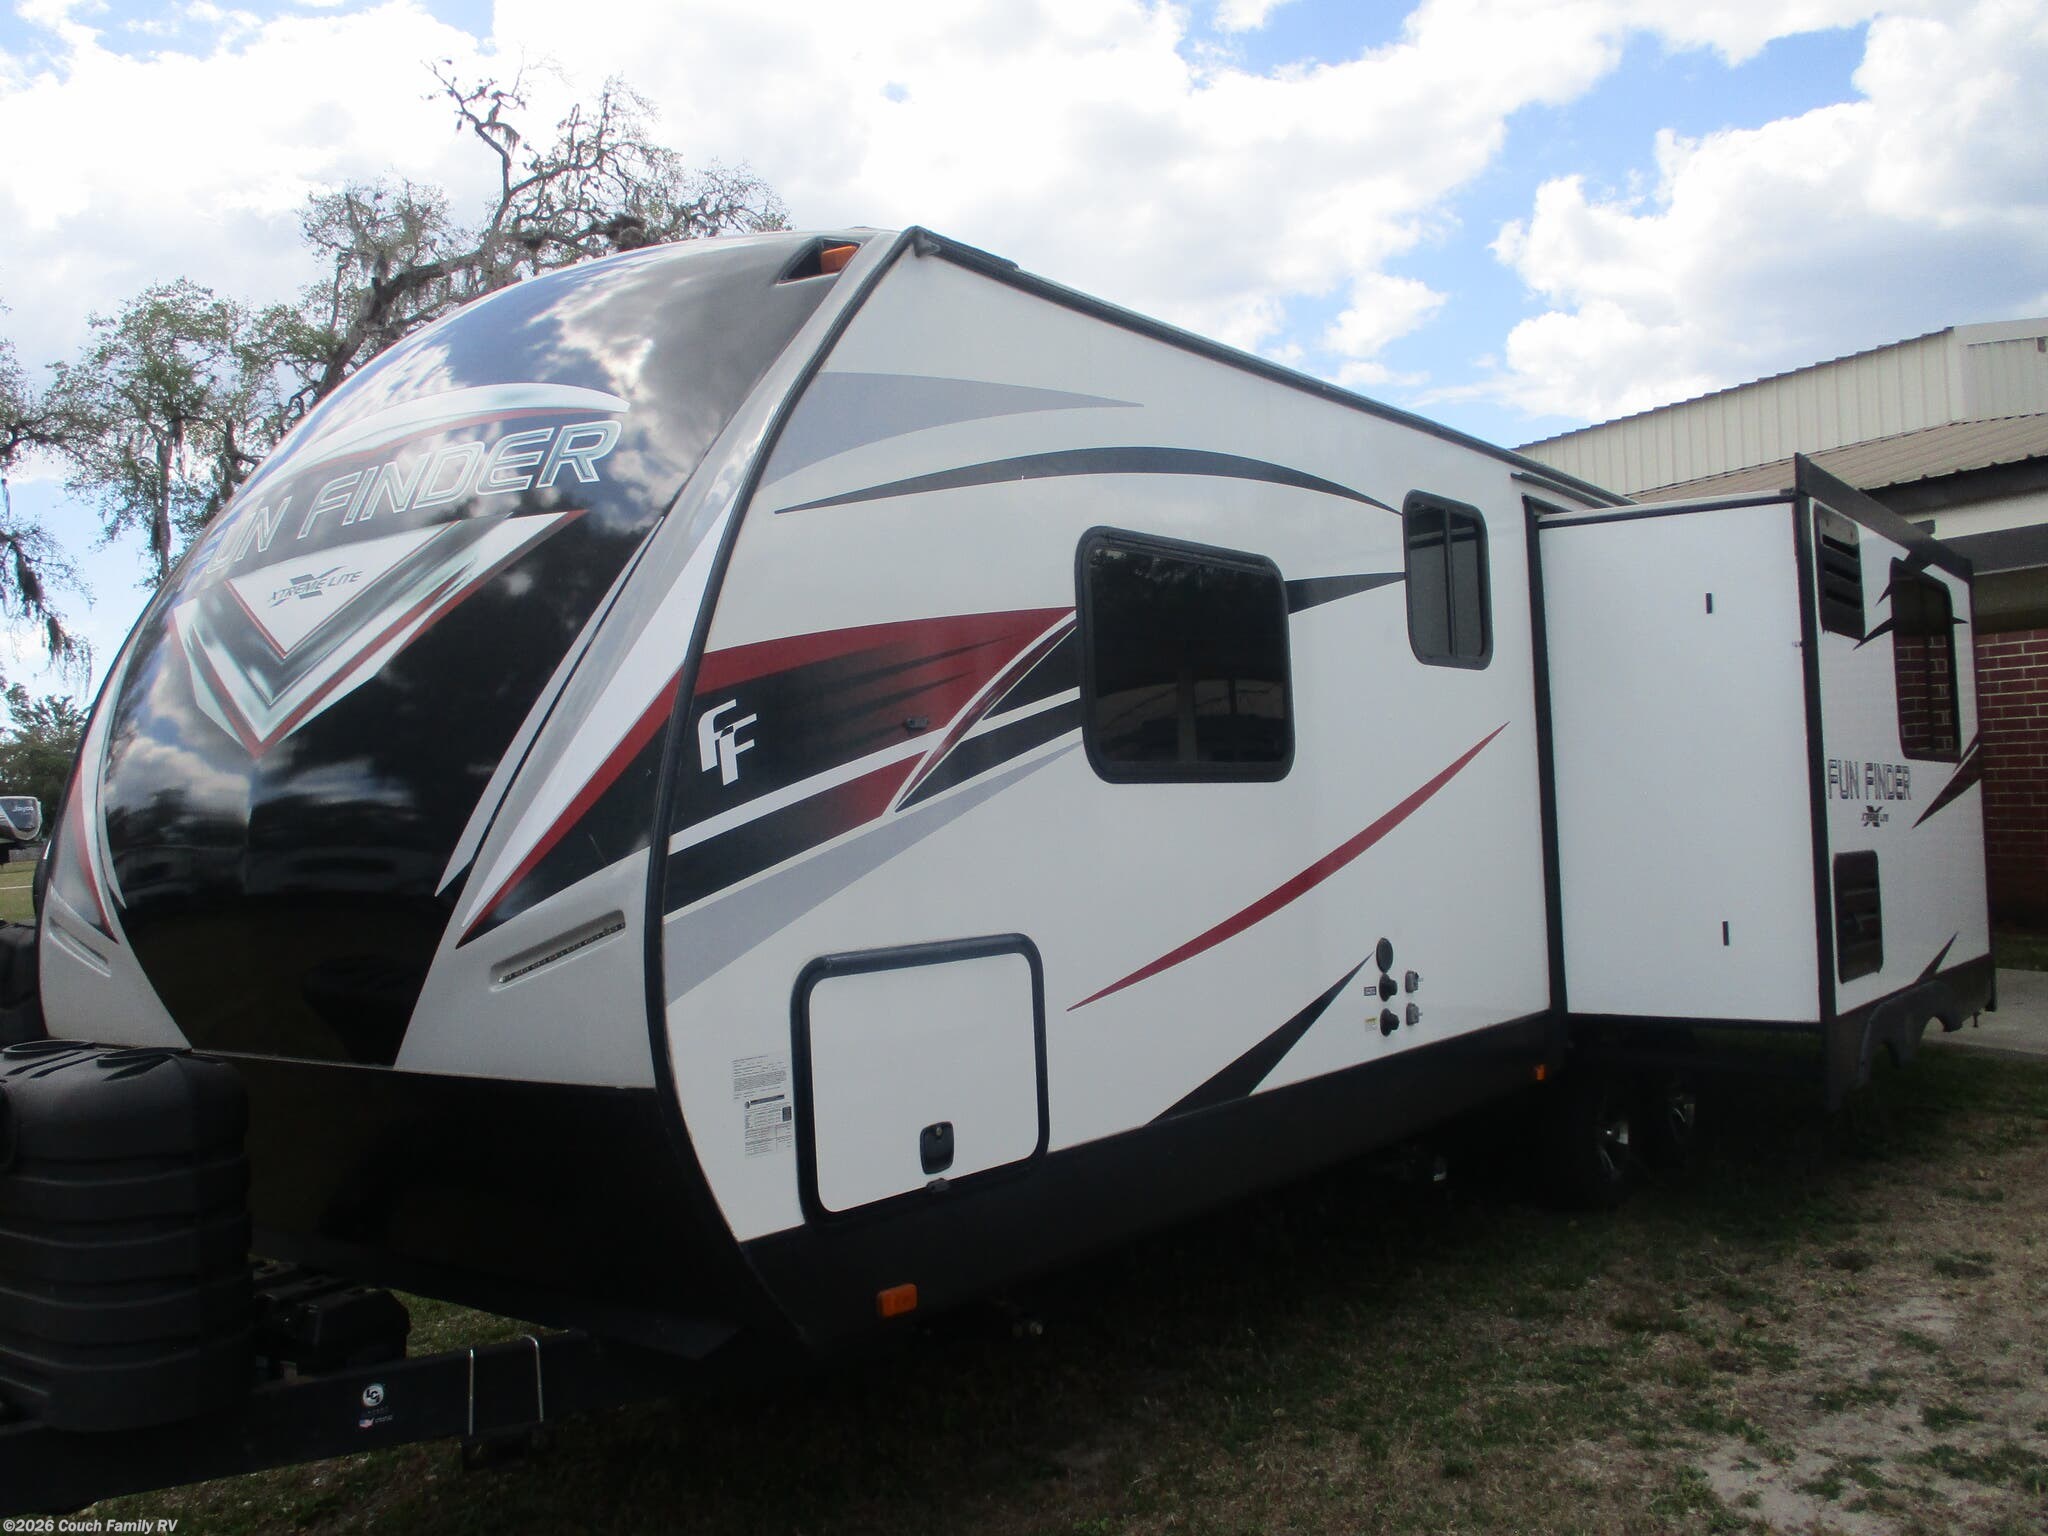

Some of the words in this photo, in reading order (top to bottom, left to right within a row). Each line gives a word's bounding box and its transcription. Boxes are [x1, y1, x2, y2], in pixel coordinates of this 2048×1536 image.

[296, 420, 622, 540] FINDER
[267, 570, 329, 606] XTREME
[328, 570, 364, 587] LITE
[1828, 758, 1860, 801] FUN
[1865, 762, 1913, 801] FINDER
